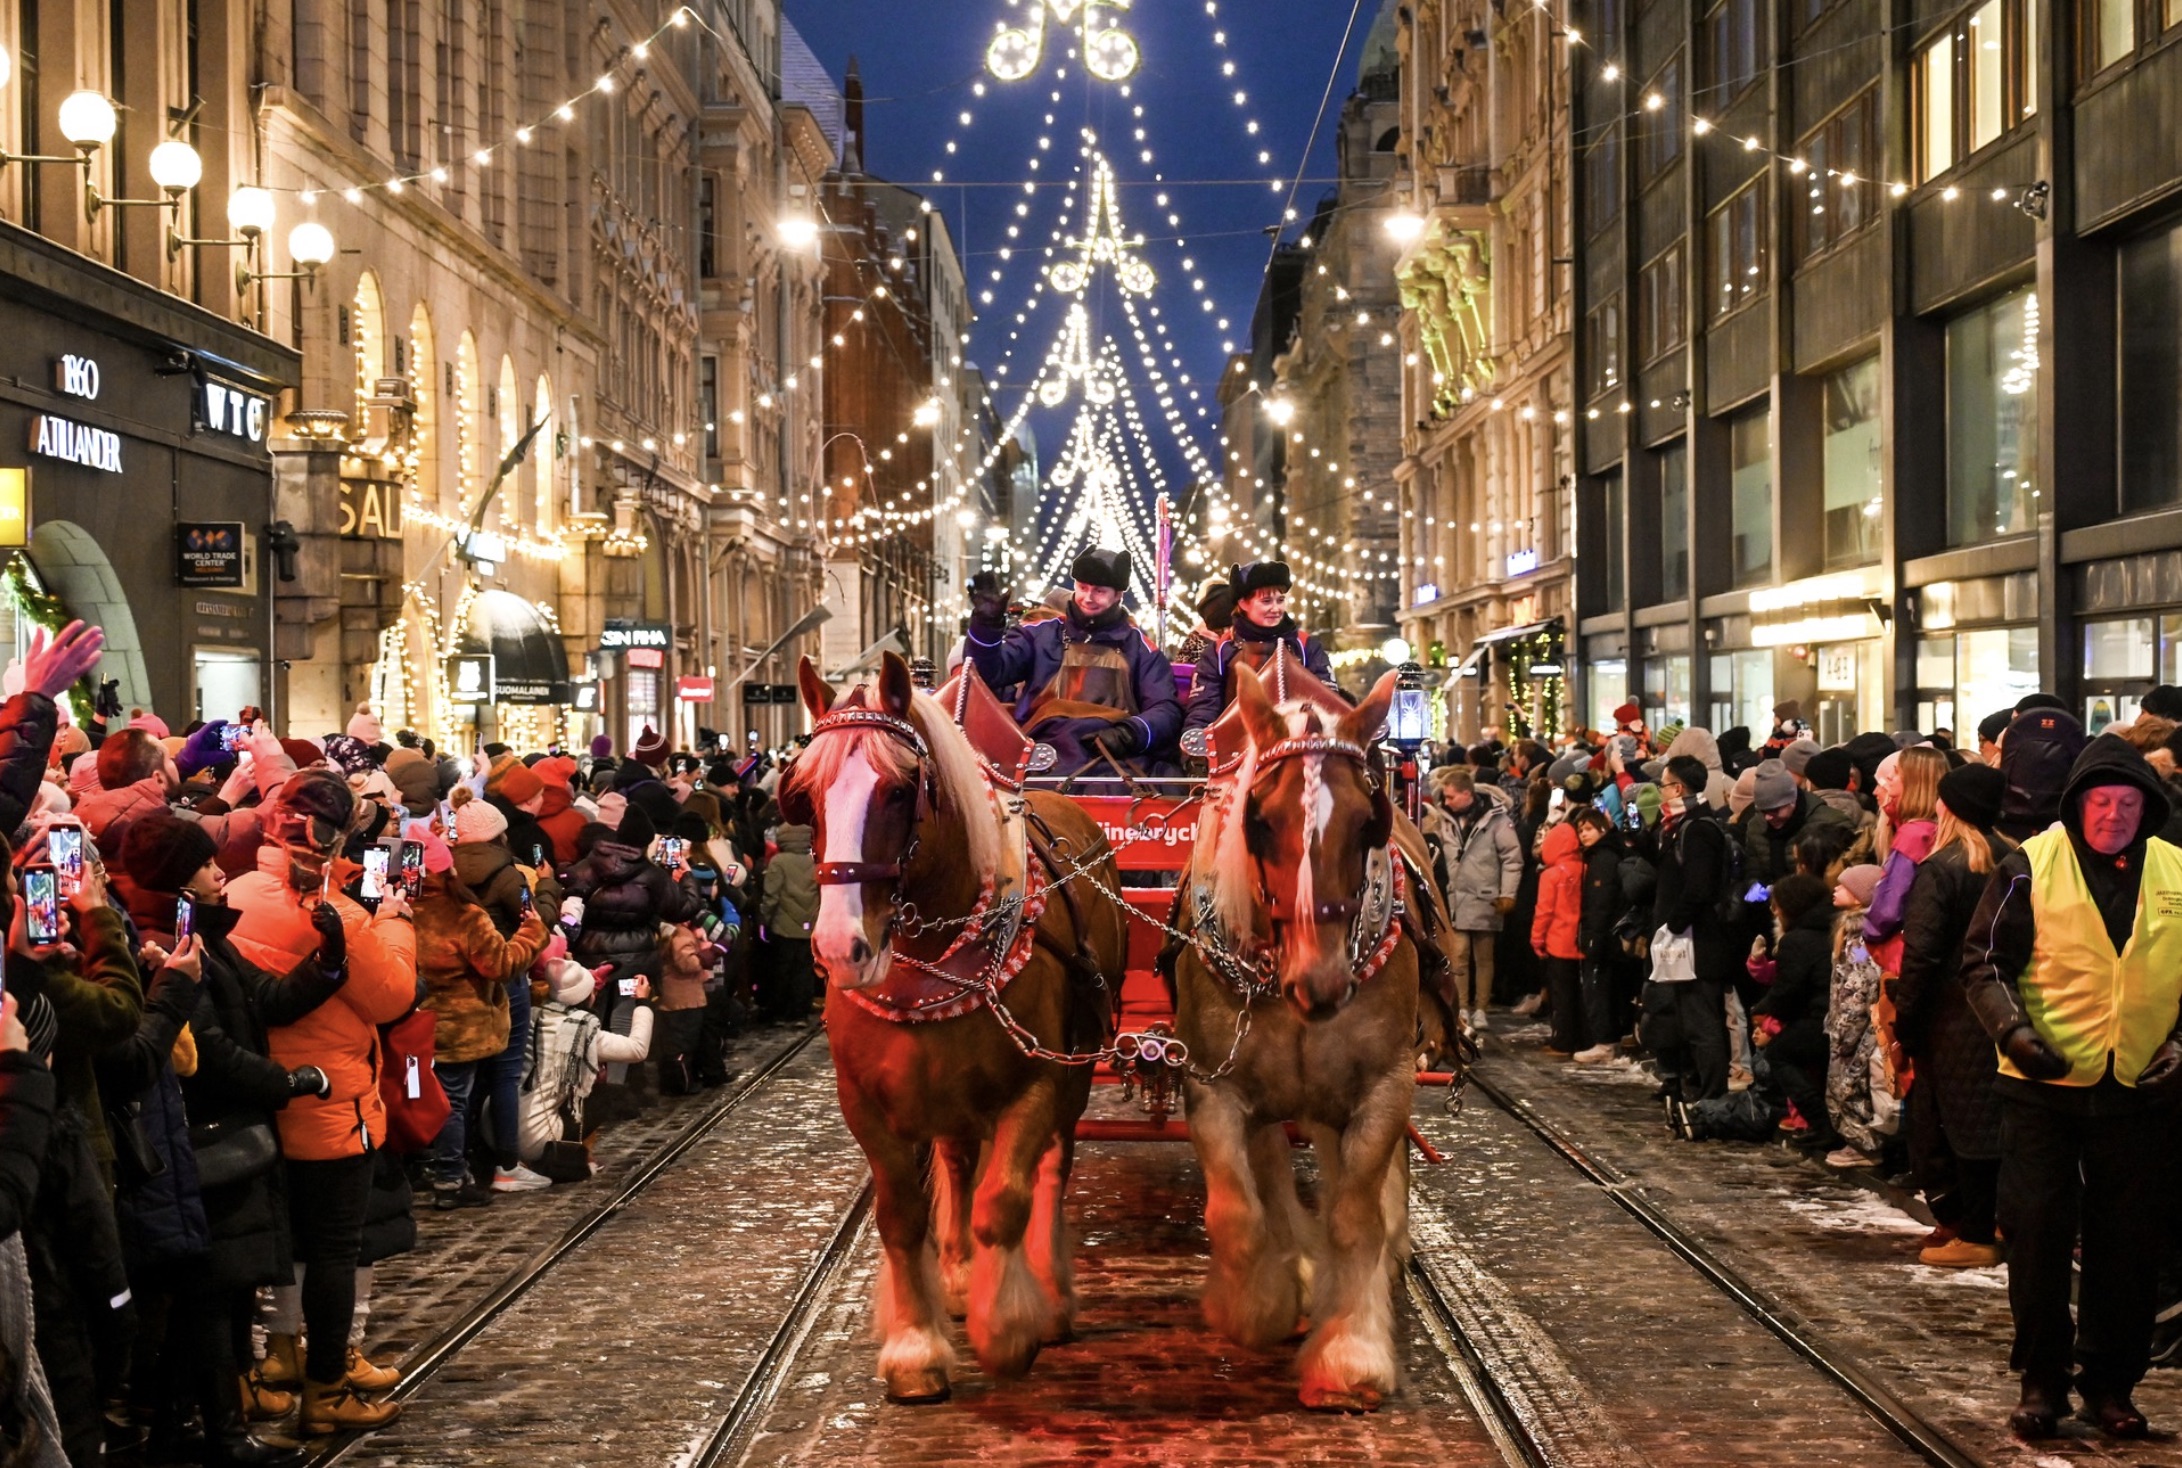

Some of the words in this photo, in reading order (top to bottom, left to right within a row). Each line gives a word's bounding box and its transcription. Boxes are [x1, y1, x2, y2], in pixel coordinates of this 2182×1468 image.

[61, 353, 99, 400] 1860
[205, 383, 266, 442] WTC
[183, 552, 211, 560] WORLD
[212, 552, 236, 560] TRADE
[494, 684, 550, 696] SUOMALAINEN
